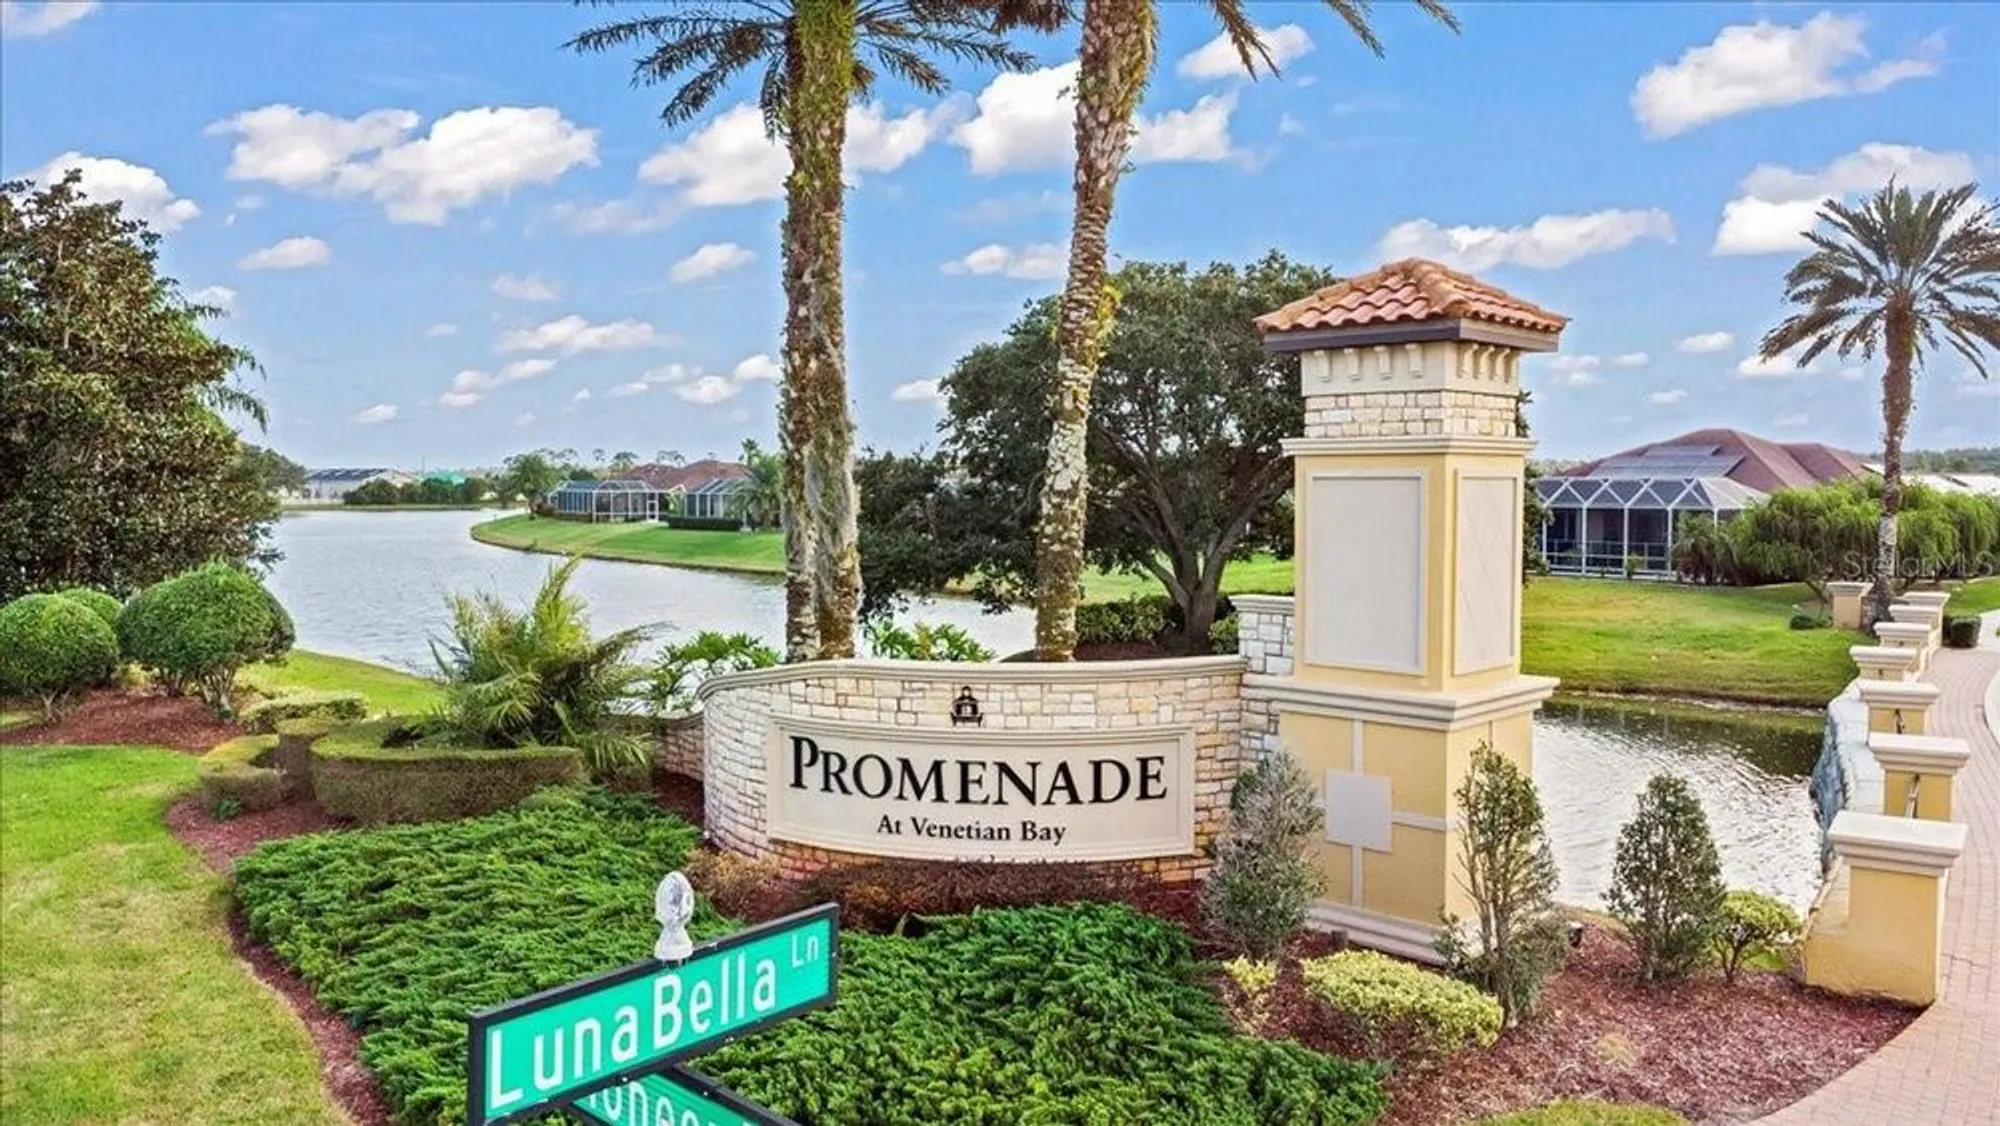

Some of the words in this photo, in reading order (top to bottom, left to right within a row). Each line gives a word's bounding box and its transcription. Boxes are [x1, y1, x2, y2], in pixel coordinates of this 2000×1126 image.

[788, 735, 1168, 808] PROMENADE
[877, 814, 901, 835] At
[910, 816, 1011, 841] Venetian
[1021, 820, 1067, 846] Bay
[791, 932, 820, 968] Ln
